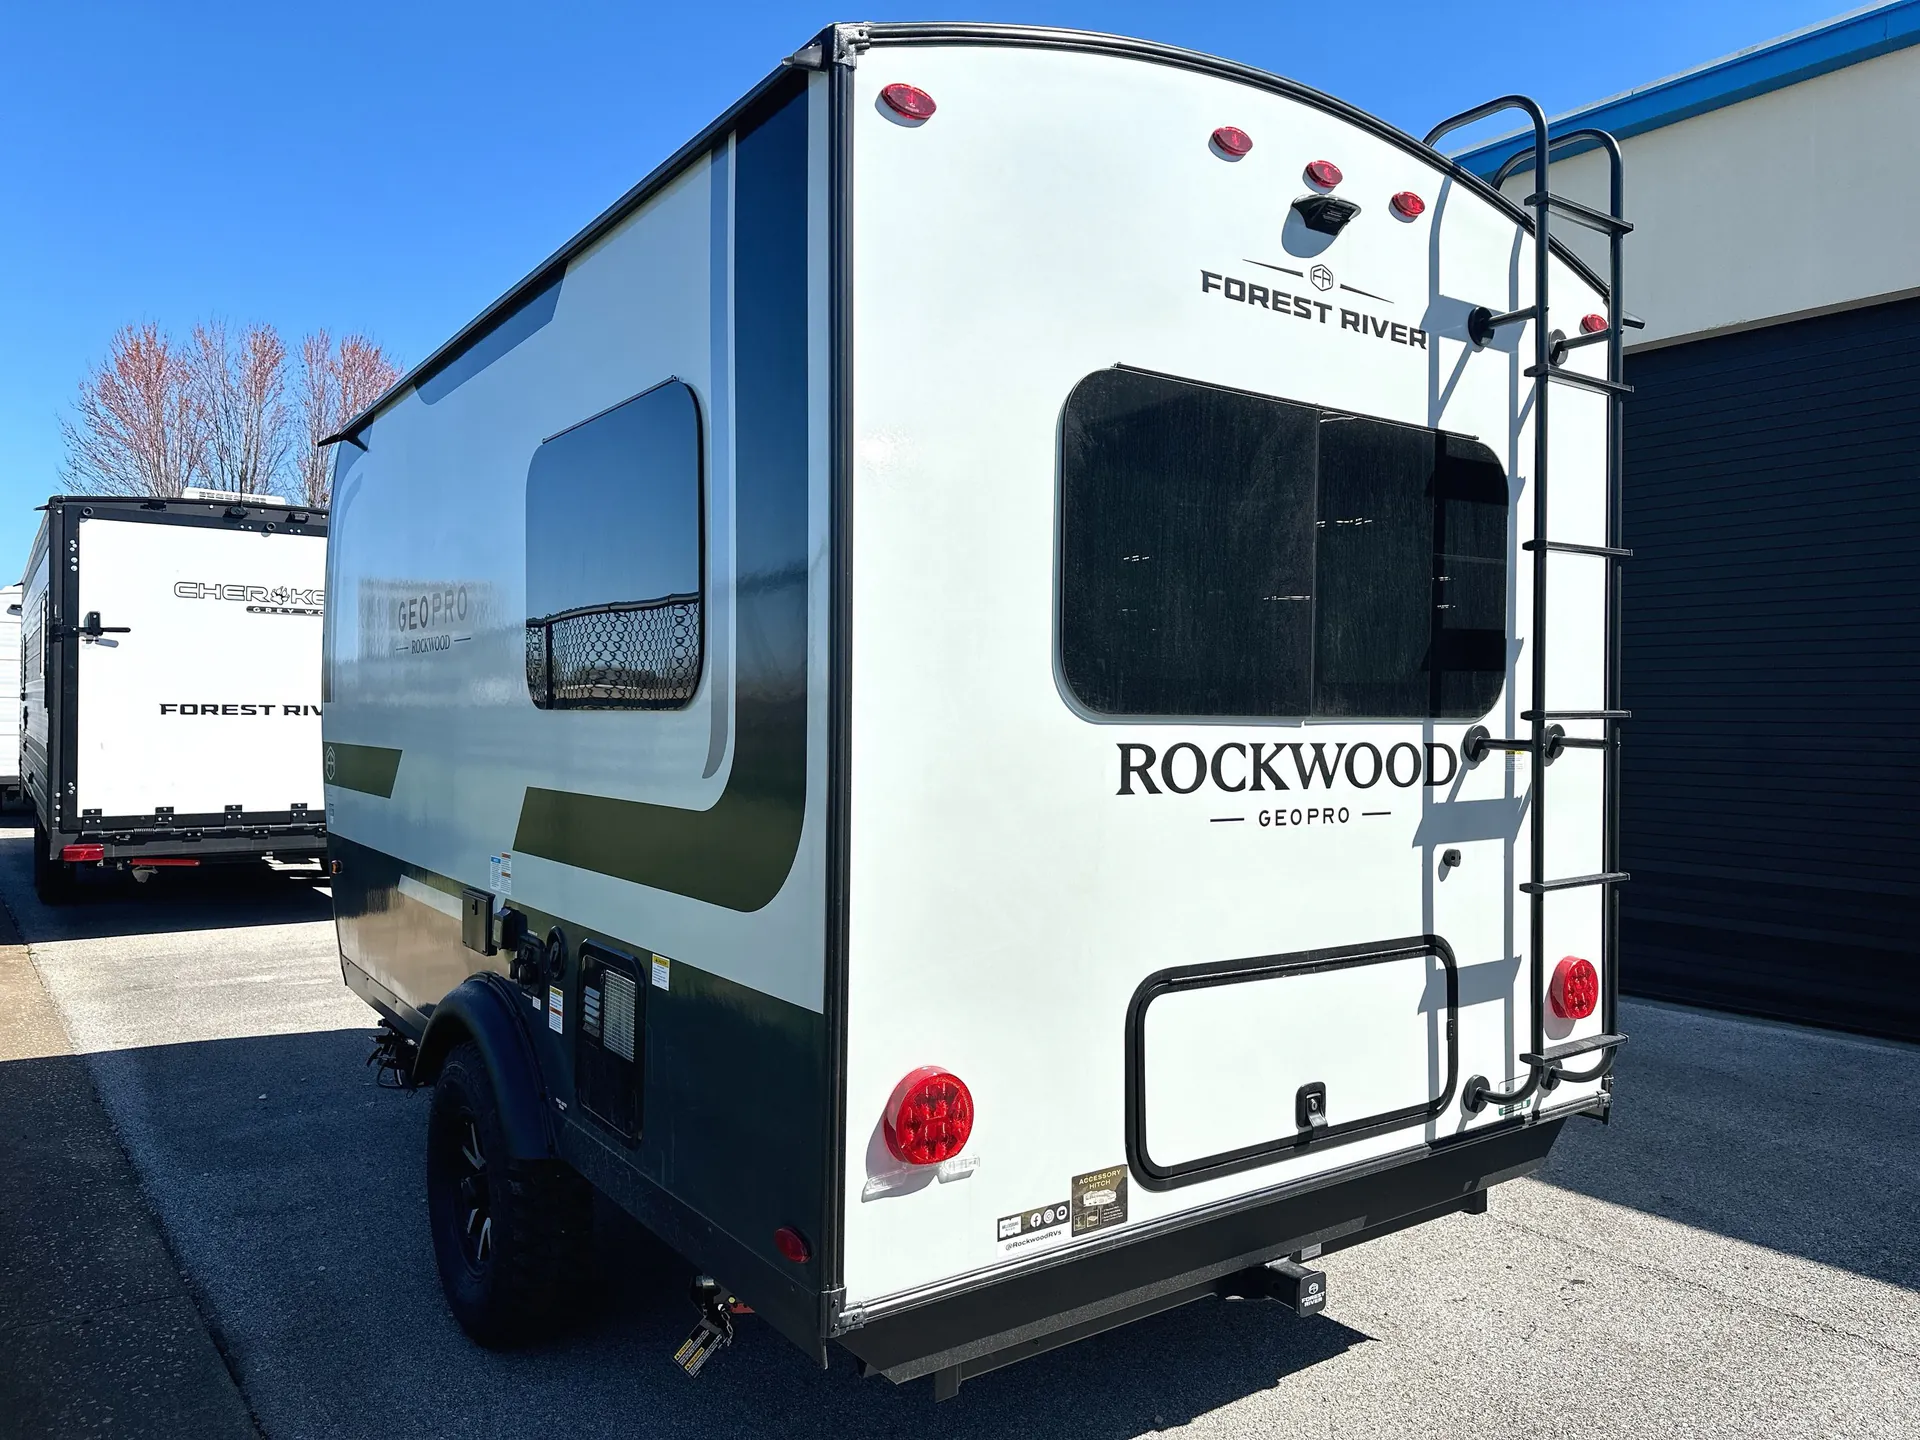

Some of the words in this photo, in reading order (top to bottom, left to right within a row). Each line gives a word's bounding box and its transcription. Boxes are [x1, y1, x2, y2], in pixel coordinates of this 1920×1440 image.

[1200, 269, 1333, 324] FOREST
[1339, 307, 1428, 350] RIVER
[252, 606, 294, 615] GREY
[398, 585, 468, 633] GEOPRO
[411, 634, 451, 655] ROCKWOOD
[159, 703, 276, 716] FOREST
[1115, 741, 1459, 796] ROCKWOOD
[1258, 806, 1350, 828] GEOPRO
[1078, 1169, 1122, 1186] ACCESSORY
[1089, 1178, 1111, 1190] HITCH
[1301, 1290, 1326, 1304] FOREST
